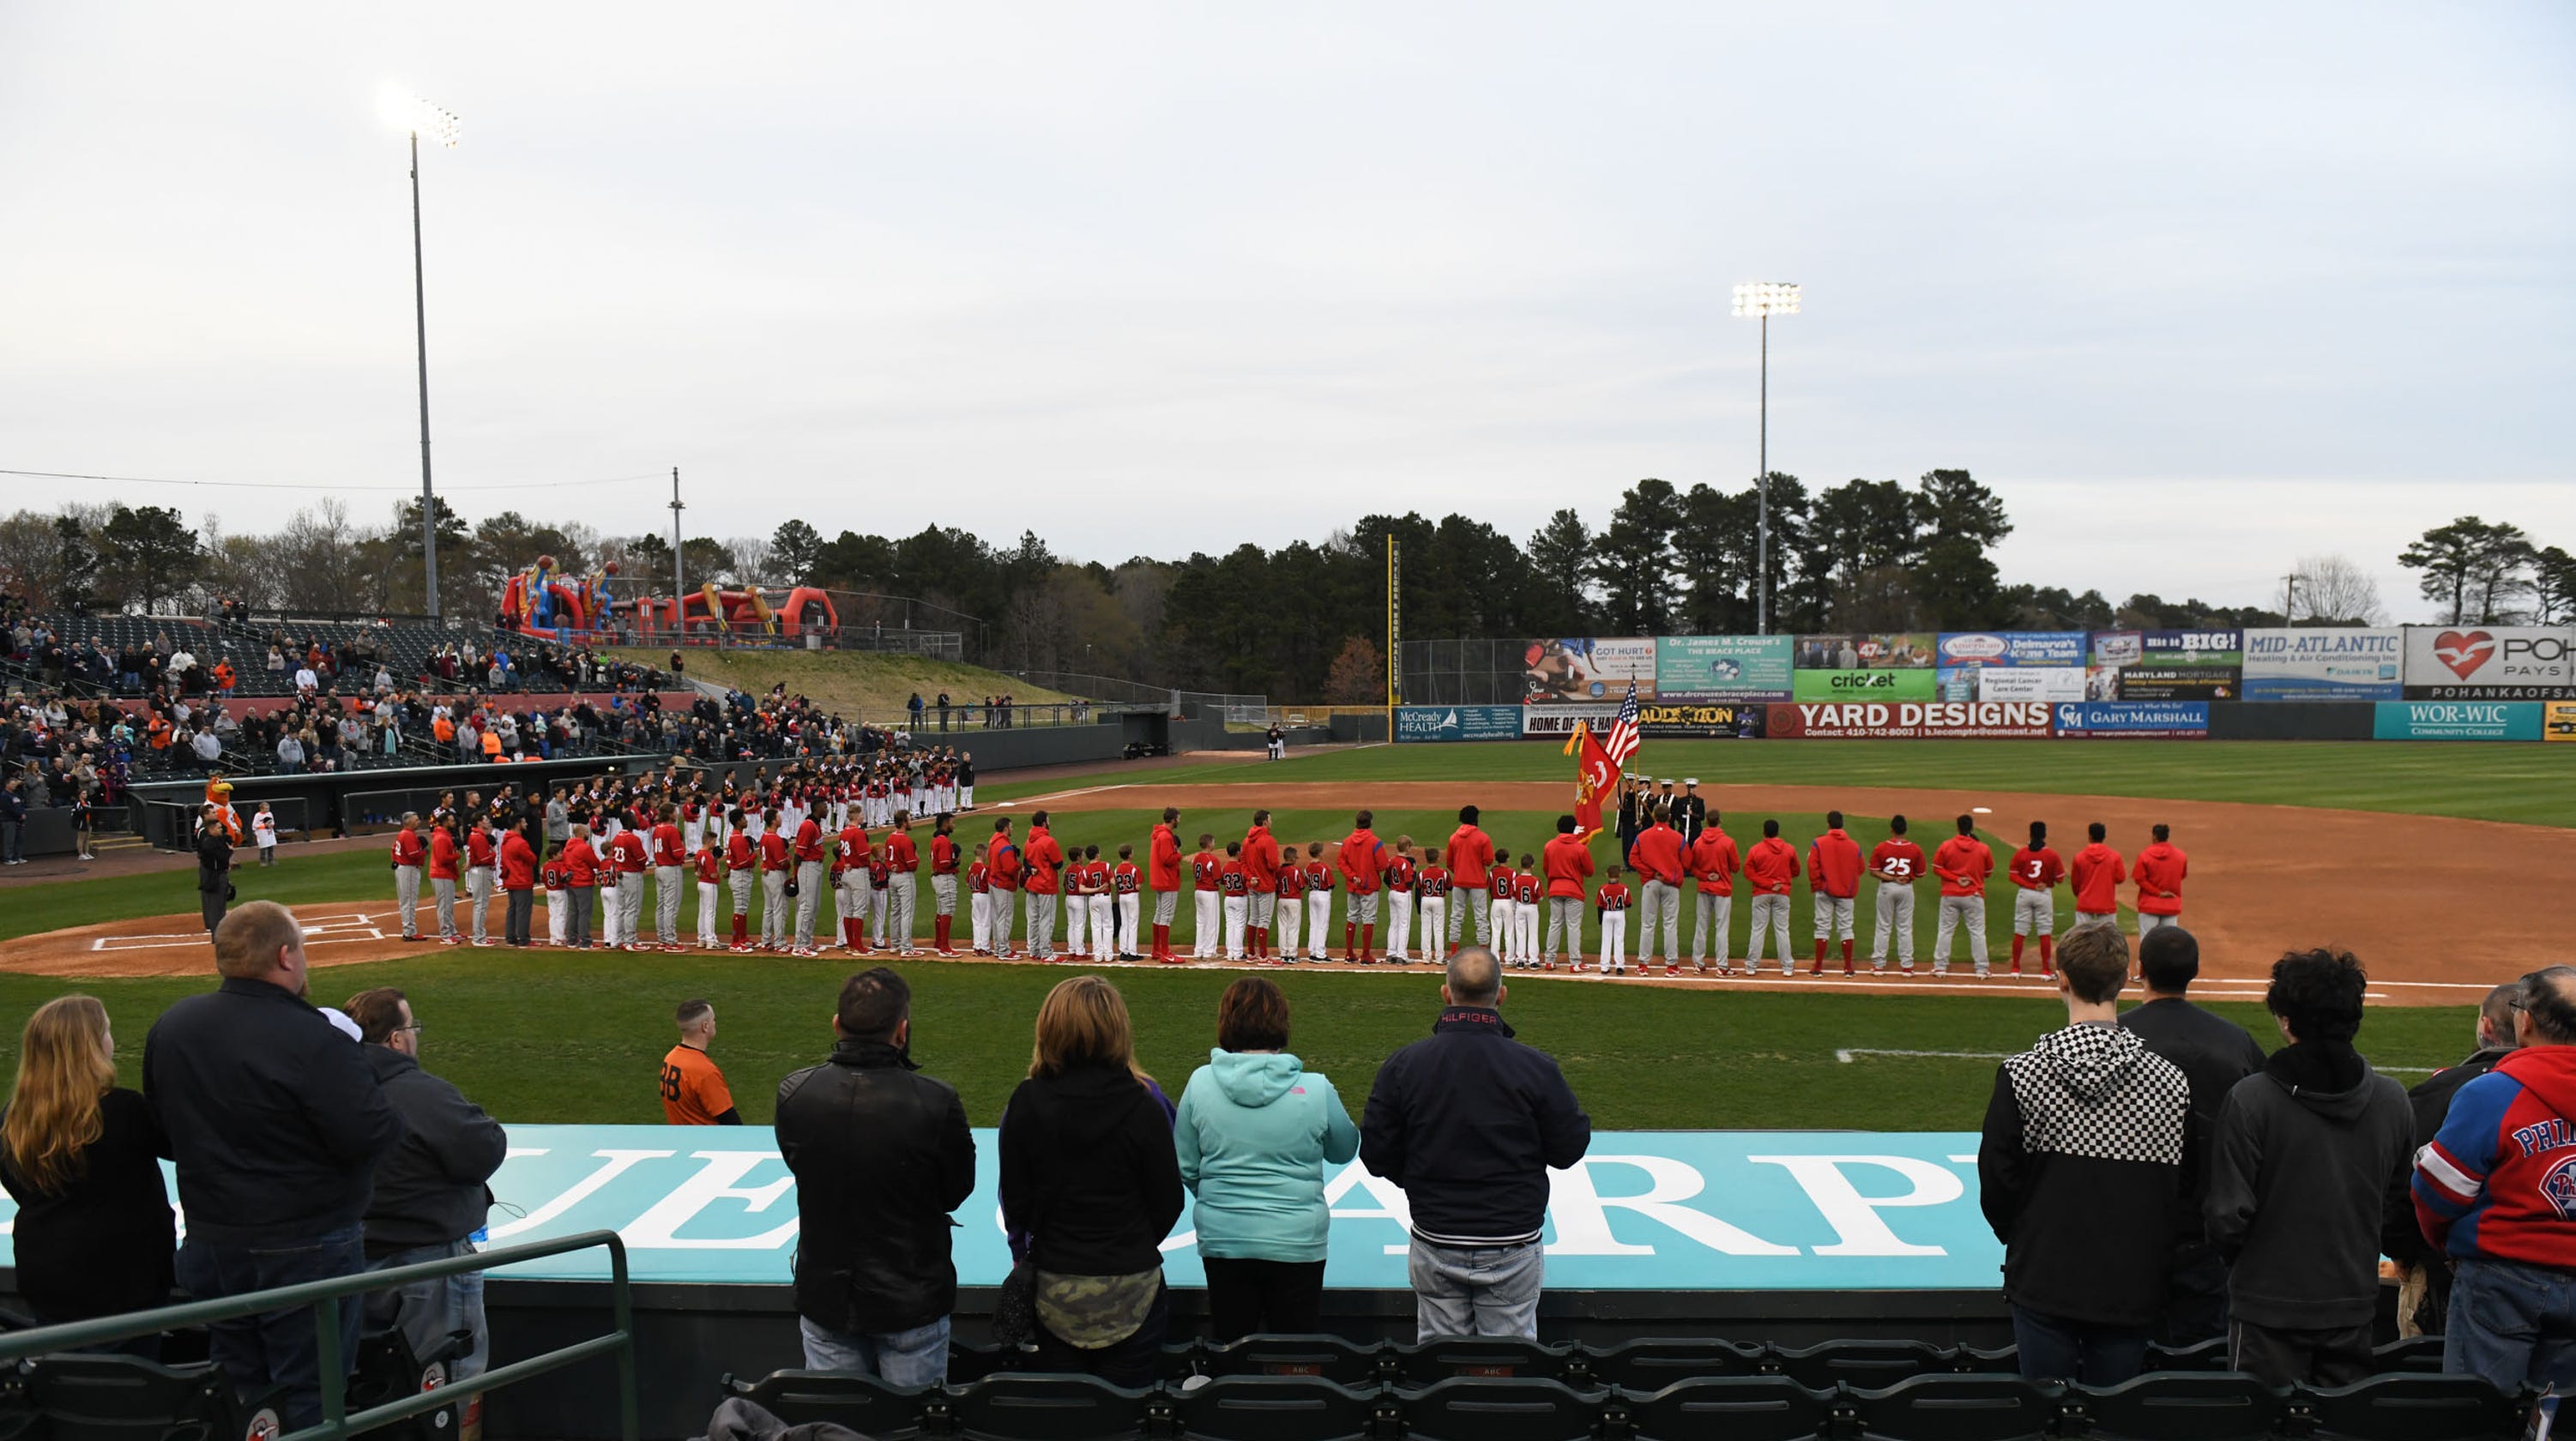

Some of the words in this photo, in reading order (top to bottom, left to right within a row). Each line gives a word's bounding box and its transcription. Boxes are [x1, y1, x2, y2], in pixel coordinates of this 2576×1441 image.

[1736, 637, 1781, 646] Crouse's
[2013, 639, 2076, 649] Delmarva's
[2181, 633, 2236, 650] BIG!
[2249, 636, 2398, 653] MID-ATLANTIC
[1596, 647, 1616, 656] GOT
[1618, 647, 1644, 655] HURT
[1859, 643, 1879, 657] 47
[2048, 648, 2078, 658] Team
[2248, 654, 2287, 664] Heating
[2316, 654, 2380, 663] Conditioning
[2383, 654, 2397, 662] Inc
[2505, 666, 2561, 676] PAYS
[1831, 672, 1896, 687] cricket
[1400, 711, 1441, 722] McCready
[1799, 705, 1890, 727] YARD
[1900, 702, 2049, 727] DESIGNS
[2090, 712, 2128, 723] GARY
[2131, 711, 2204, 723] MARSHALL
[2410, 705, 2507, 722] WOR-WIC
[1400, 722, 1442, 732] HEALTH
[1529, 717, 1560, 731] HOME
[1562, 717, 1575, 731] OF
[1805, 728, 1844, 737] Contact:
[1846, 728, 1915, 737] 410-742-8003
[1883, 857, 1911, 876] 25
[2027, 860, 2042, 878] 3
[548, 869, 556, 886] 9
[1091, 871, 1102, 888] 7
[1116, 873, 1134, 891] 23
[1222, 872, 1242, 891] 32
[1424, 878, 1444, 896] 34
[1498, 877, 1507, 895] 6
[1520, 886, 1530, 903] 6
[1606, 896, 1624, 911] 14
[1441, 1012, 1497, 1025] HILFIGER
